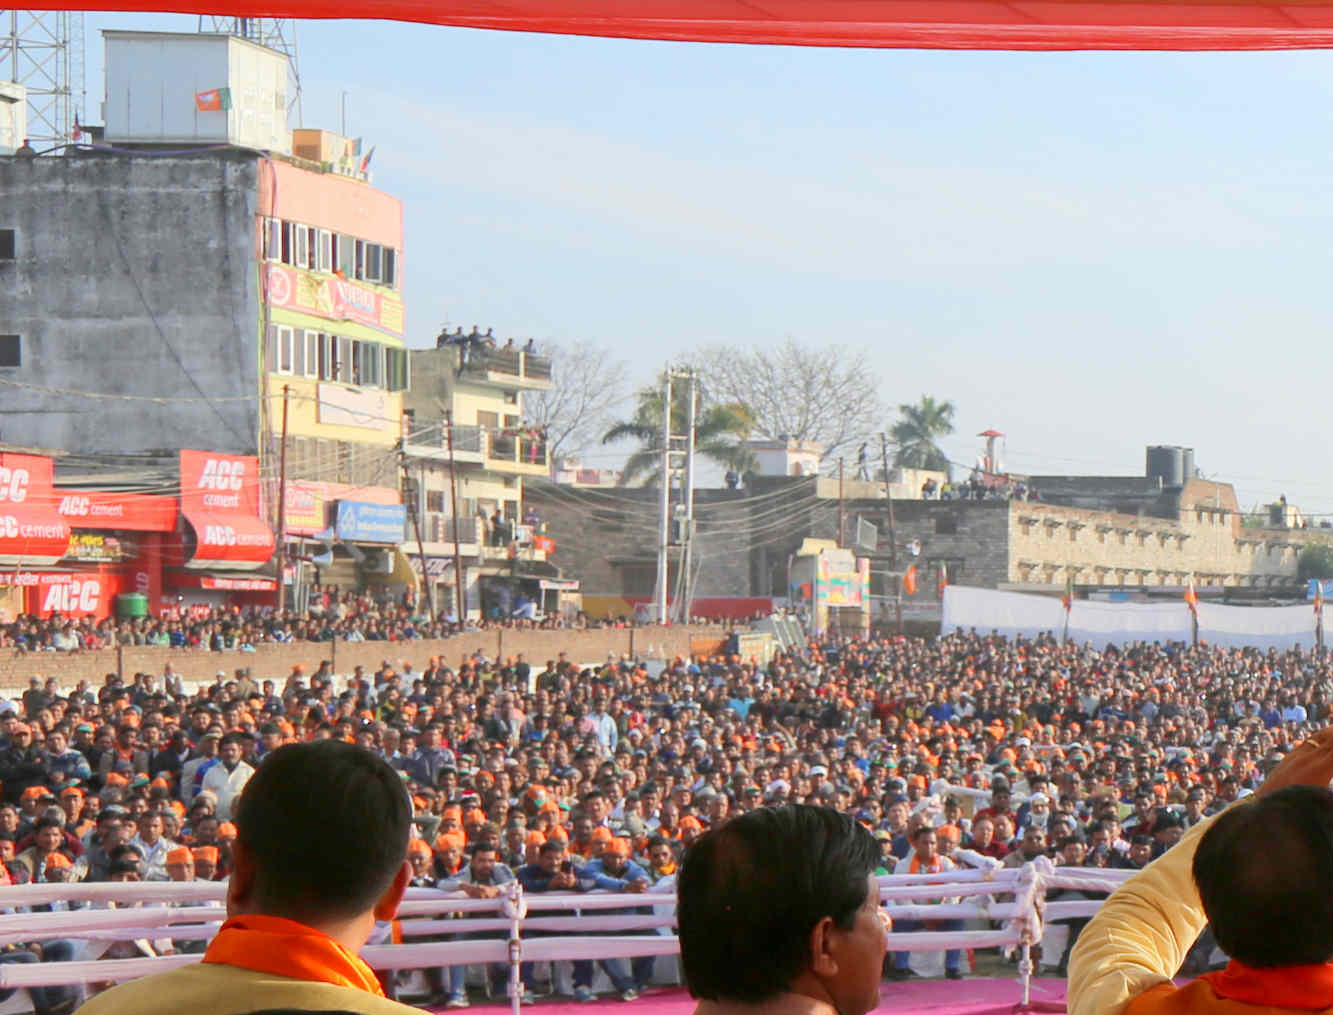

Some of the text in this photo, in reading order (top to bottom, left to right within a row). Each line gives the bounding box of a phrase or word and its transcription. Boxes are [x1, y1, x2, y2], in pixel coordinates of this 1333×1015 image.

[0, 467, 29, 502] CC
[197, 459, 245, 490] ACC
[58, 496, 123, 516] ACC cement
[203, 493, 239, 507] cement
[20, 523, 65, 539] cement
[204, 525, 272, 546] ACC cement
[43, 580, 100, 612] ACC
